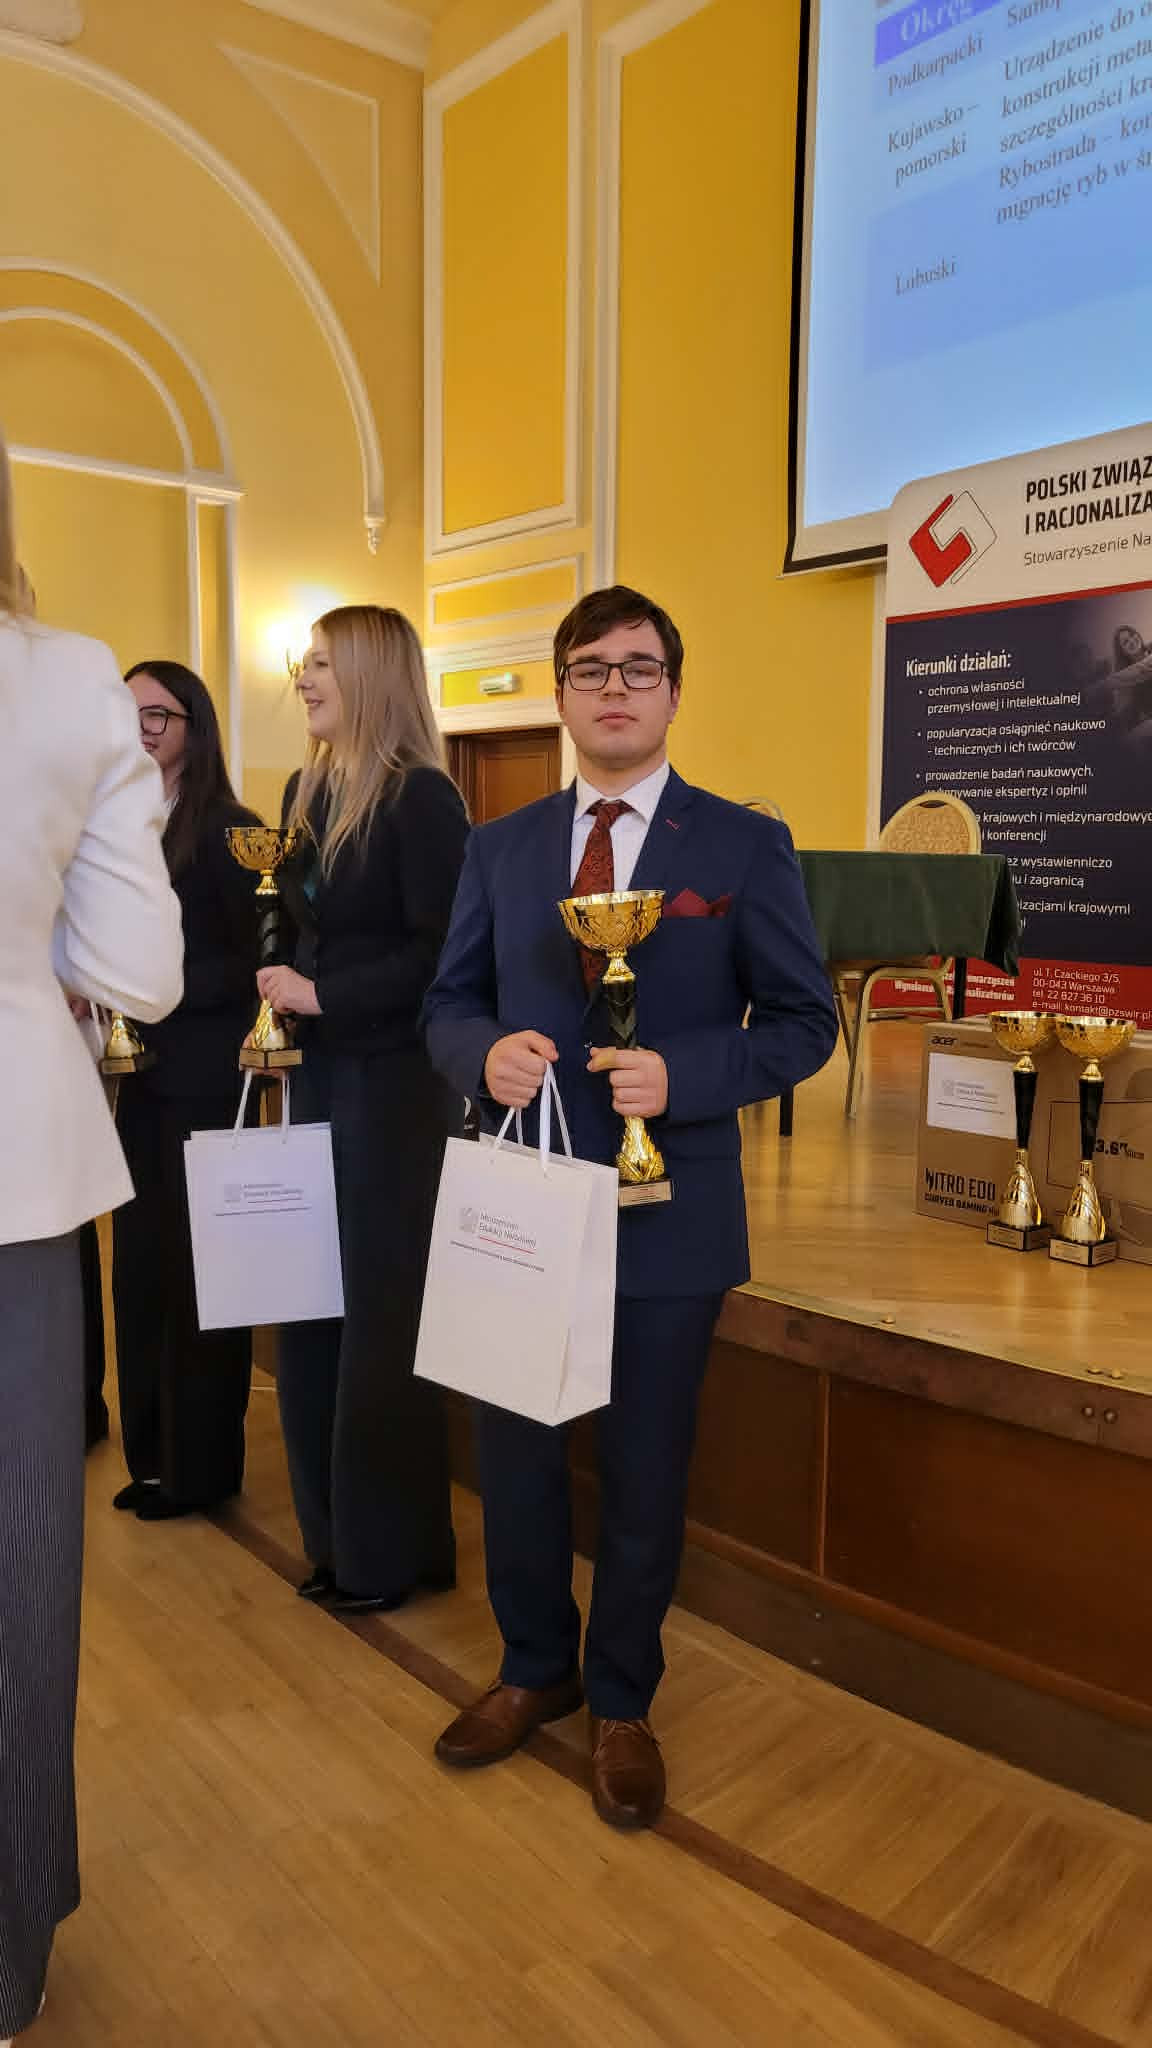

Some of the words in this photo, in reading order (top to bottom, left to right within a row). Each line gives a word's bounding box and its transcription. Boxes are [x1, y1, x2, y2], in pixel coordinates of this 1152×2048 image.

[1109, 8, 1135, 32] do
[888, 105, 962, 153] Kujawsko
[895, 132, 966, 188] pomorski
[1077, 163, 1107, 196] ryb
[1113, 159, 1129, 177] w
[1026, 469, 1087, 503] POLSKI
[1091, 455, 1152, 489] ZWIĄZ
[1025, 514, 1030, 535] I
[1035, 488, 1152, 534] RACJONALIZA
[1024, 536, 1129, 567] Stowarzyszenie
[906, 655, 957, 677] Kierunki
[959, 649, 1012, 673] działań:
[927, 684, 969, 697] ochrona
[971, 678, 1025, 695] własności
[927, 699, 1000, 717] przemysłowej
[1006, 692, 1081, 709] intelektualnej
[927, 727, 997, 742] popularyzacja
[999, 722, 1051, 740] osiągnięć
[1053, 719, 1106, 734] naukowo
[934, 743, 1002, 757] technicznych
[1009, 741, 1025, 753] ich
[1027, 738, 1076, 752] twórców
[925, 770, 989, 786] prowadzenie
[991, 766, 1024, 781] badań
[995, 785, 1048, 801] ekspertyz
[1056, 783, 1087, 799] opinii
[983, 811, 1037, 825] krajowych
[987, 828, 1047, 843] konferencji
[1020, 856, 1112, 870] wystawienniczo
[1030, 874, 1084, 888] zagranicą
[1068, 900, 1131, 916] krajowymi
[1054, 968, 1100, 983] Czackiego
[1032, 977, 1067, 990] 00-043
[1069, 981, 1115, 994] Warszawa
[1047, 989, 1059, 1000] 22
[1080, 993, 1092, 1003] 36
[1094, 994, 1106, 1004] 10
[931, 1035, 957, 1046] acer
[925, 1167, 964, 1194] NITRO
